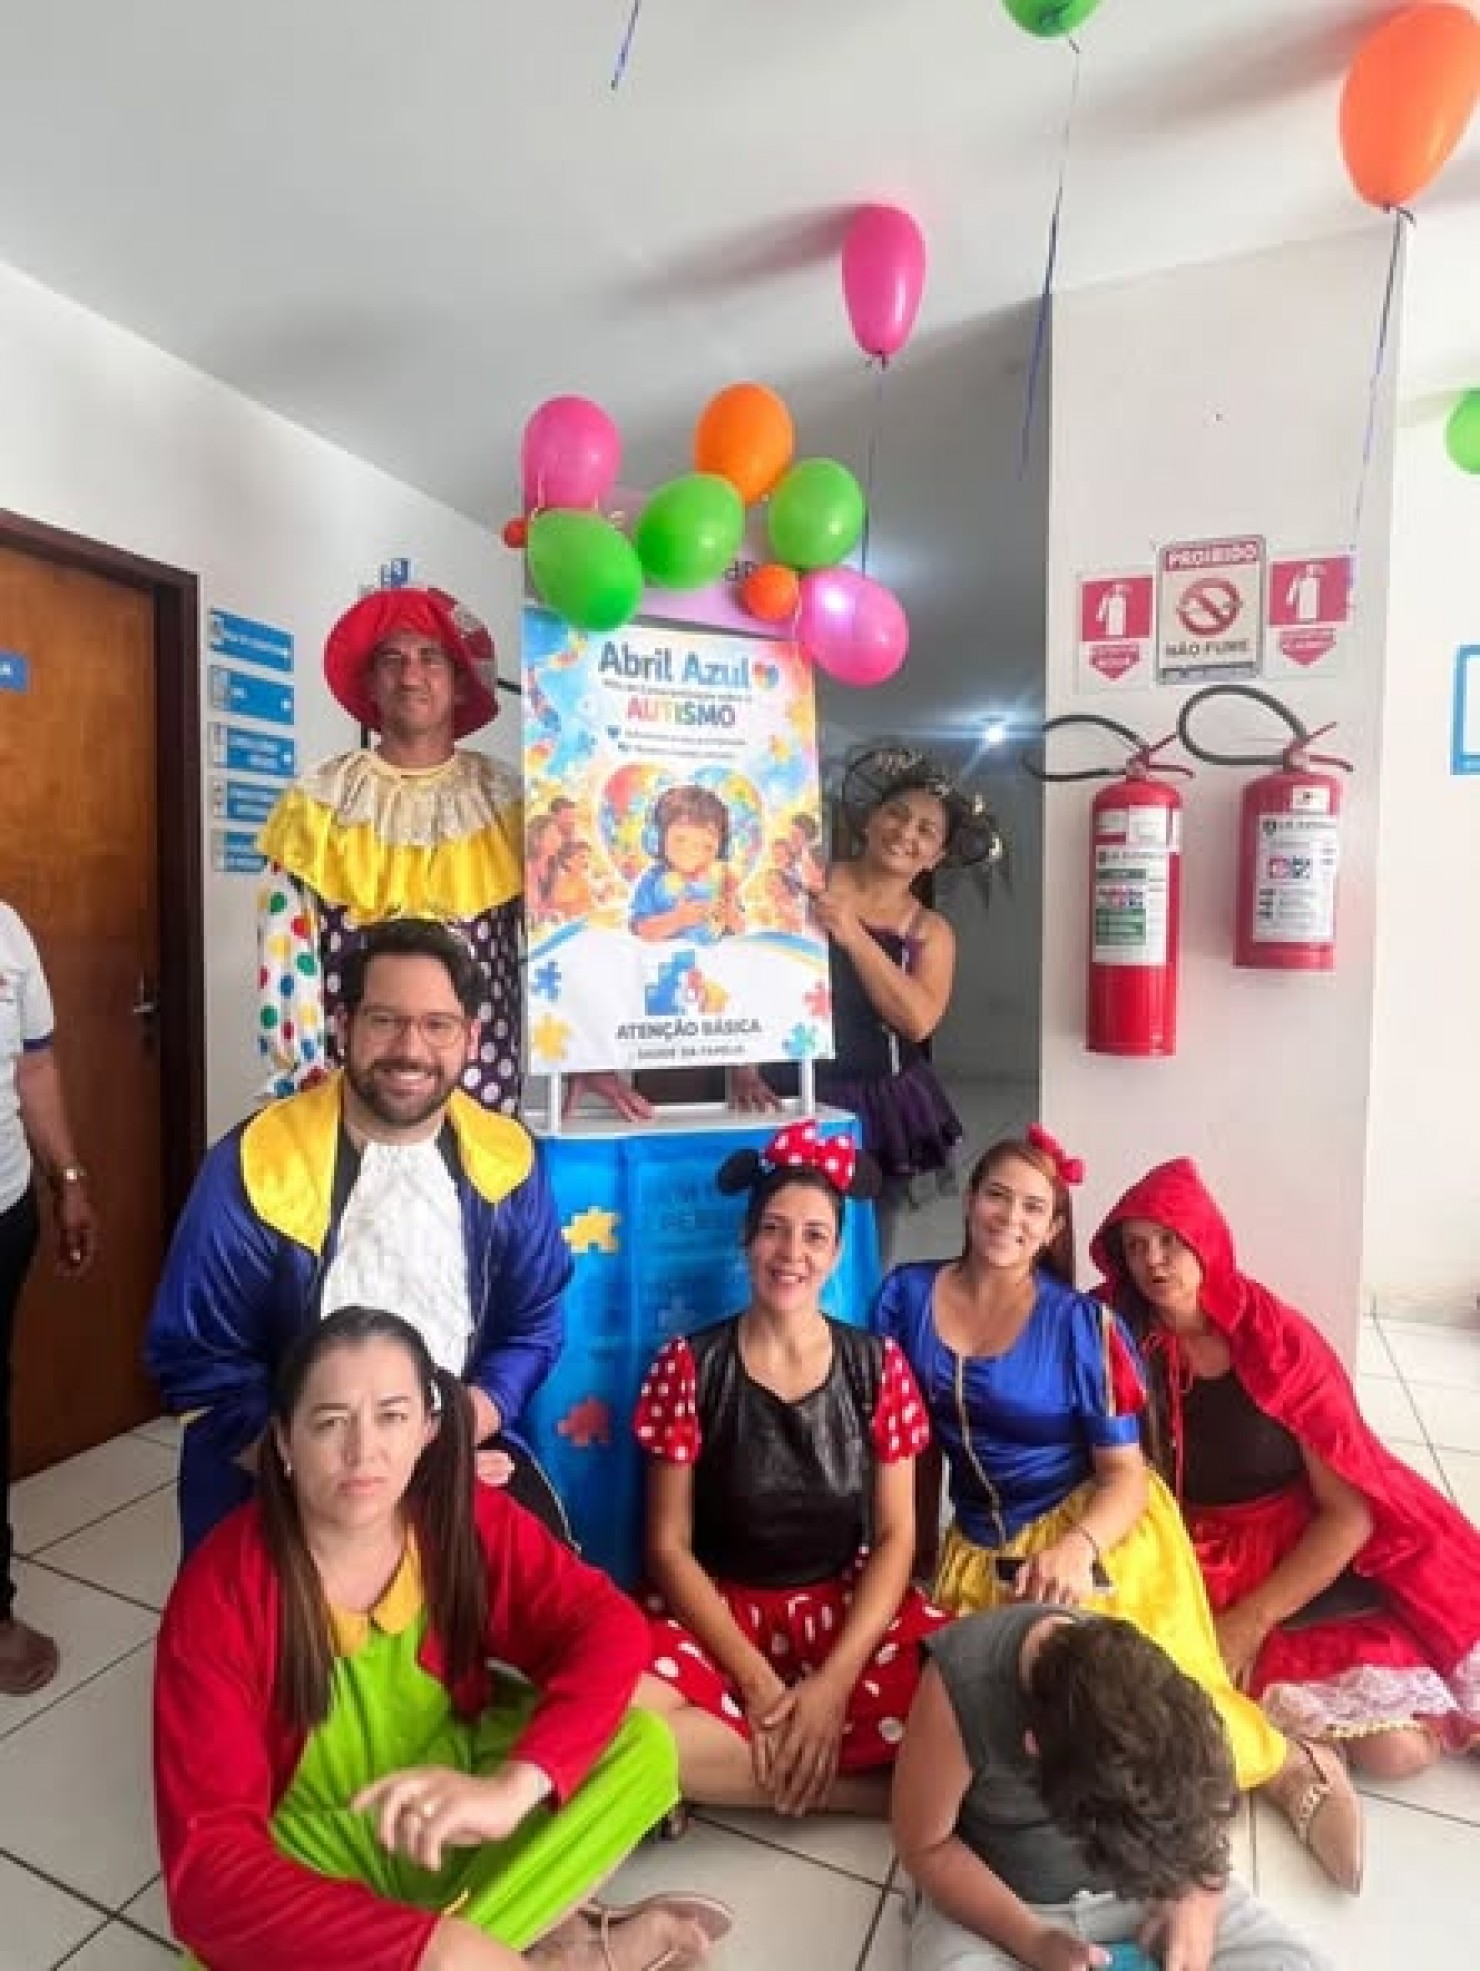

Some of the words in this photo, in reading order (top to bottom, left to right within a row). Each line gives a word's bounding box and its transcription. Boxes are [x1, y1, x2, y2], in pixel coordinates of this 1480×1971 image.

[1168, 543, 1257, 567] PROIBIDO
[1165, 641, 1200, 658] NÃO
[1205, 639, 1249, 654] FUME
[598, 641, 673, 682] Abril
[682, 652, 749, 689] Azul
[626, 696, 736, 729] AUTISMO
[616, 1018, 698, 1042] ATENÇÃO
[702, 1017, 763, 1037] BÁSICA
